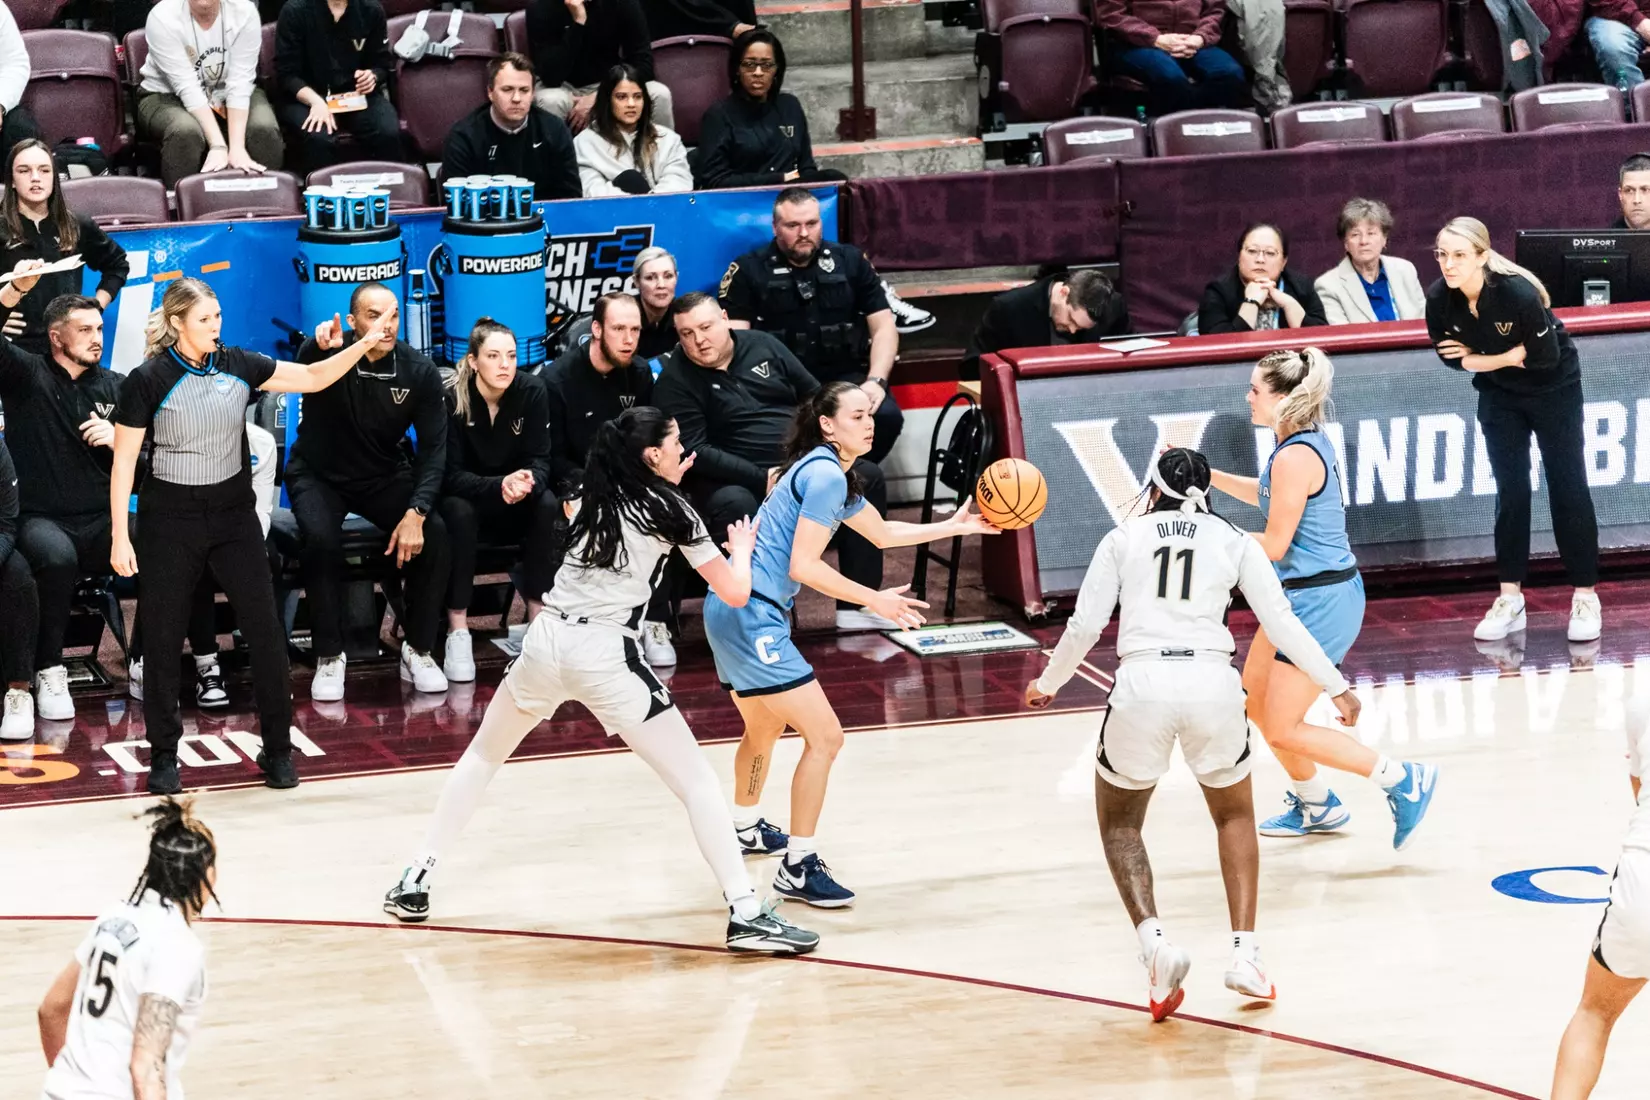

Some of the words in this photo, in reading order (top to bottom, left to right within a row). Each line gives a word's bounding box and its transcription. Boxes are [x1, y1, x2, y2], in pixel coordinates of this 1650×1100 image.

[319, 260, 400, 282] POWERADE
[463, 252, 543, 273] POWERADE
[1495, 322, 1513, 336] V
[751, 361, 771, 379] V
[389, 387, 410, 404] V
[1157, 520, 1197, 540] OLIVER
[1153, 546, 1195, 601] 11
[755, 635, 781, 665] C
